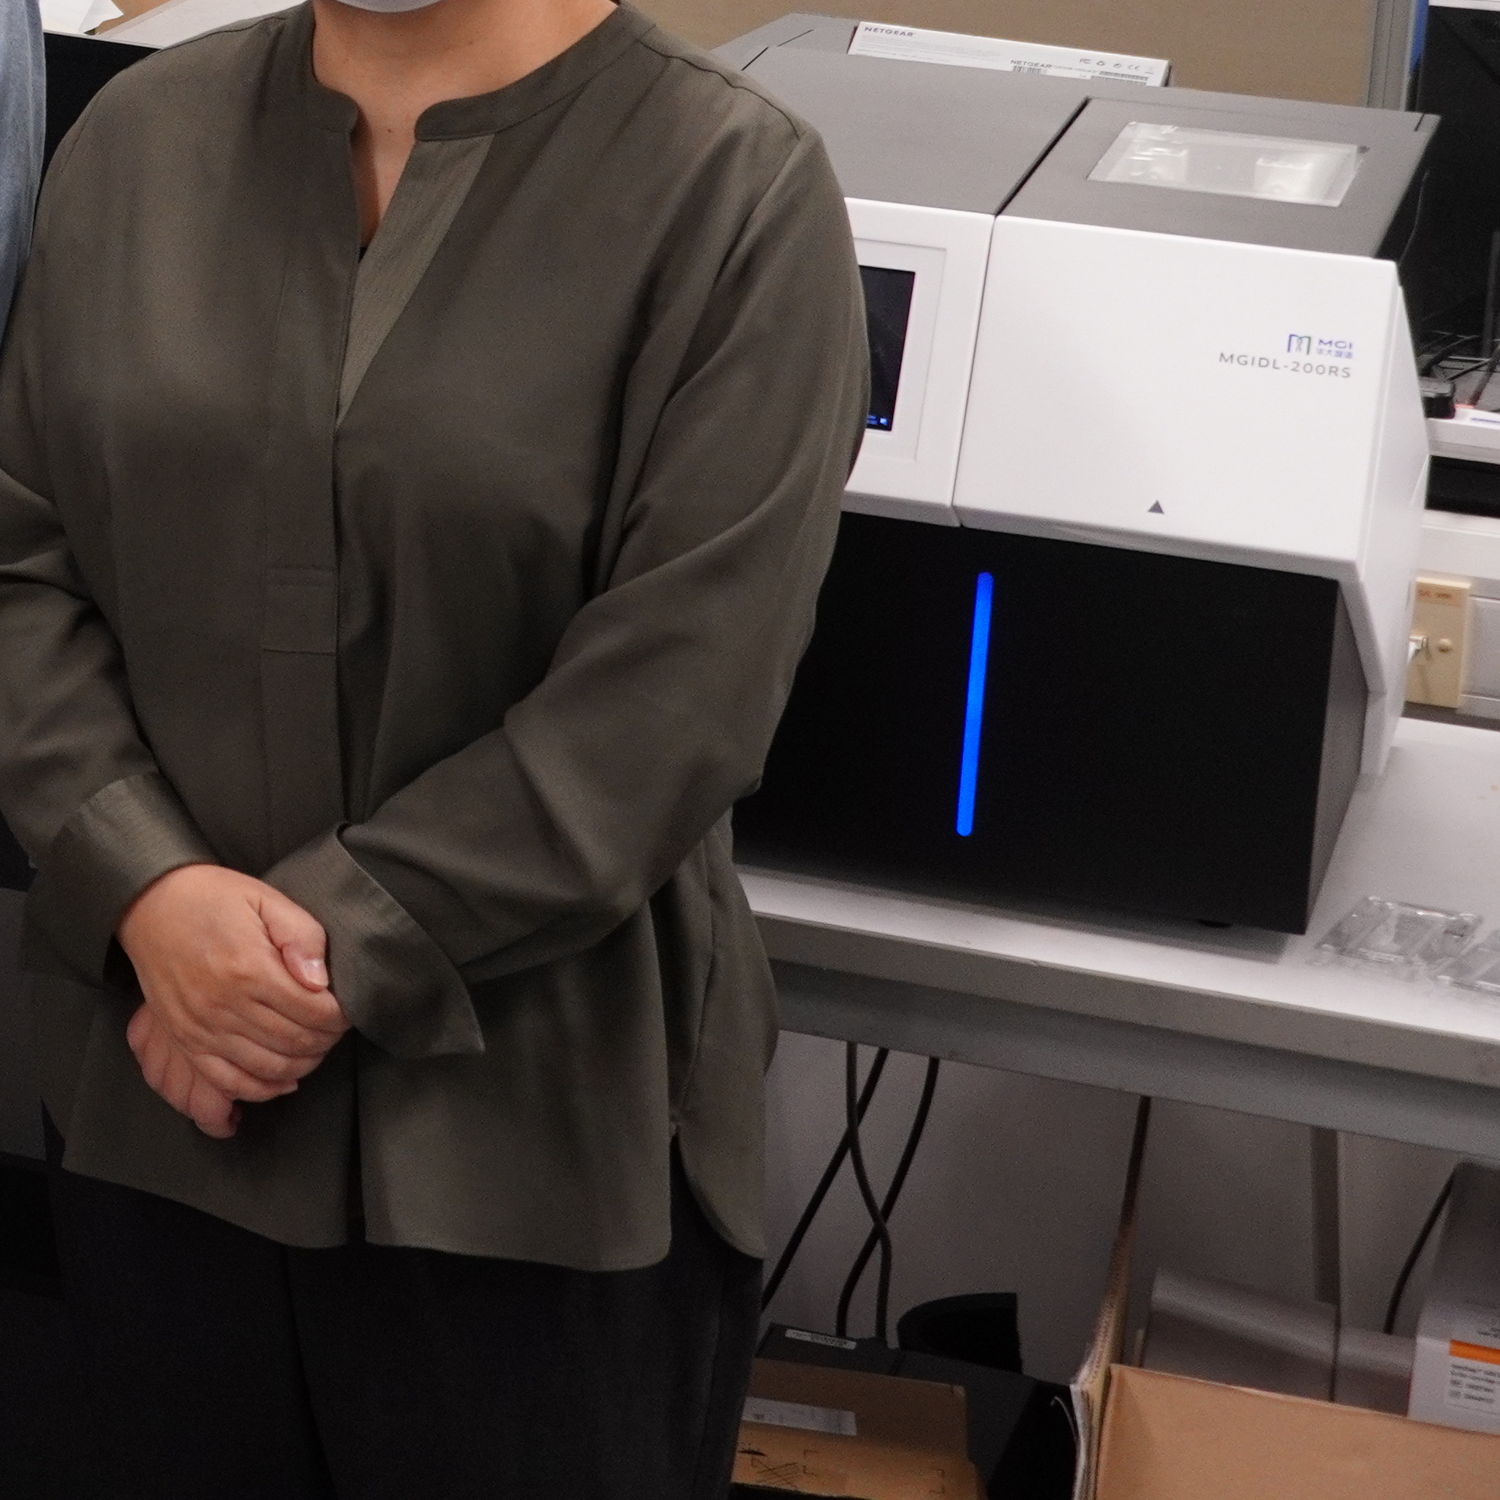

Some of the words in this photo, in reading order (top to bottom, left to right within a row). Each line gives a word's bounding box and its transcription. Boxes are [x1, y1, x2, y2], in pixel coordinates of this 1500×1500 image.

[864, 26, 914, 37] NETGEAR
[1010, 59, 1052, 69] NETGEAR
[1318, 339, 1352, 349] MGI
[1219, 352, 1351, 378] MGIDL-200RS
